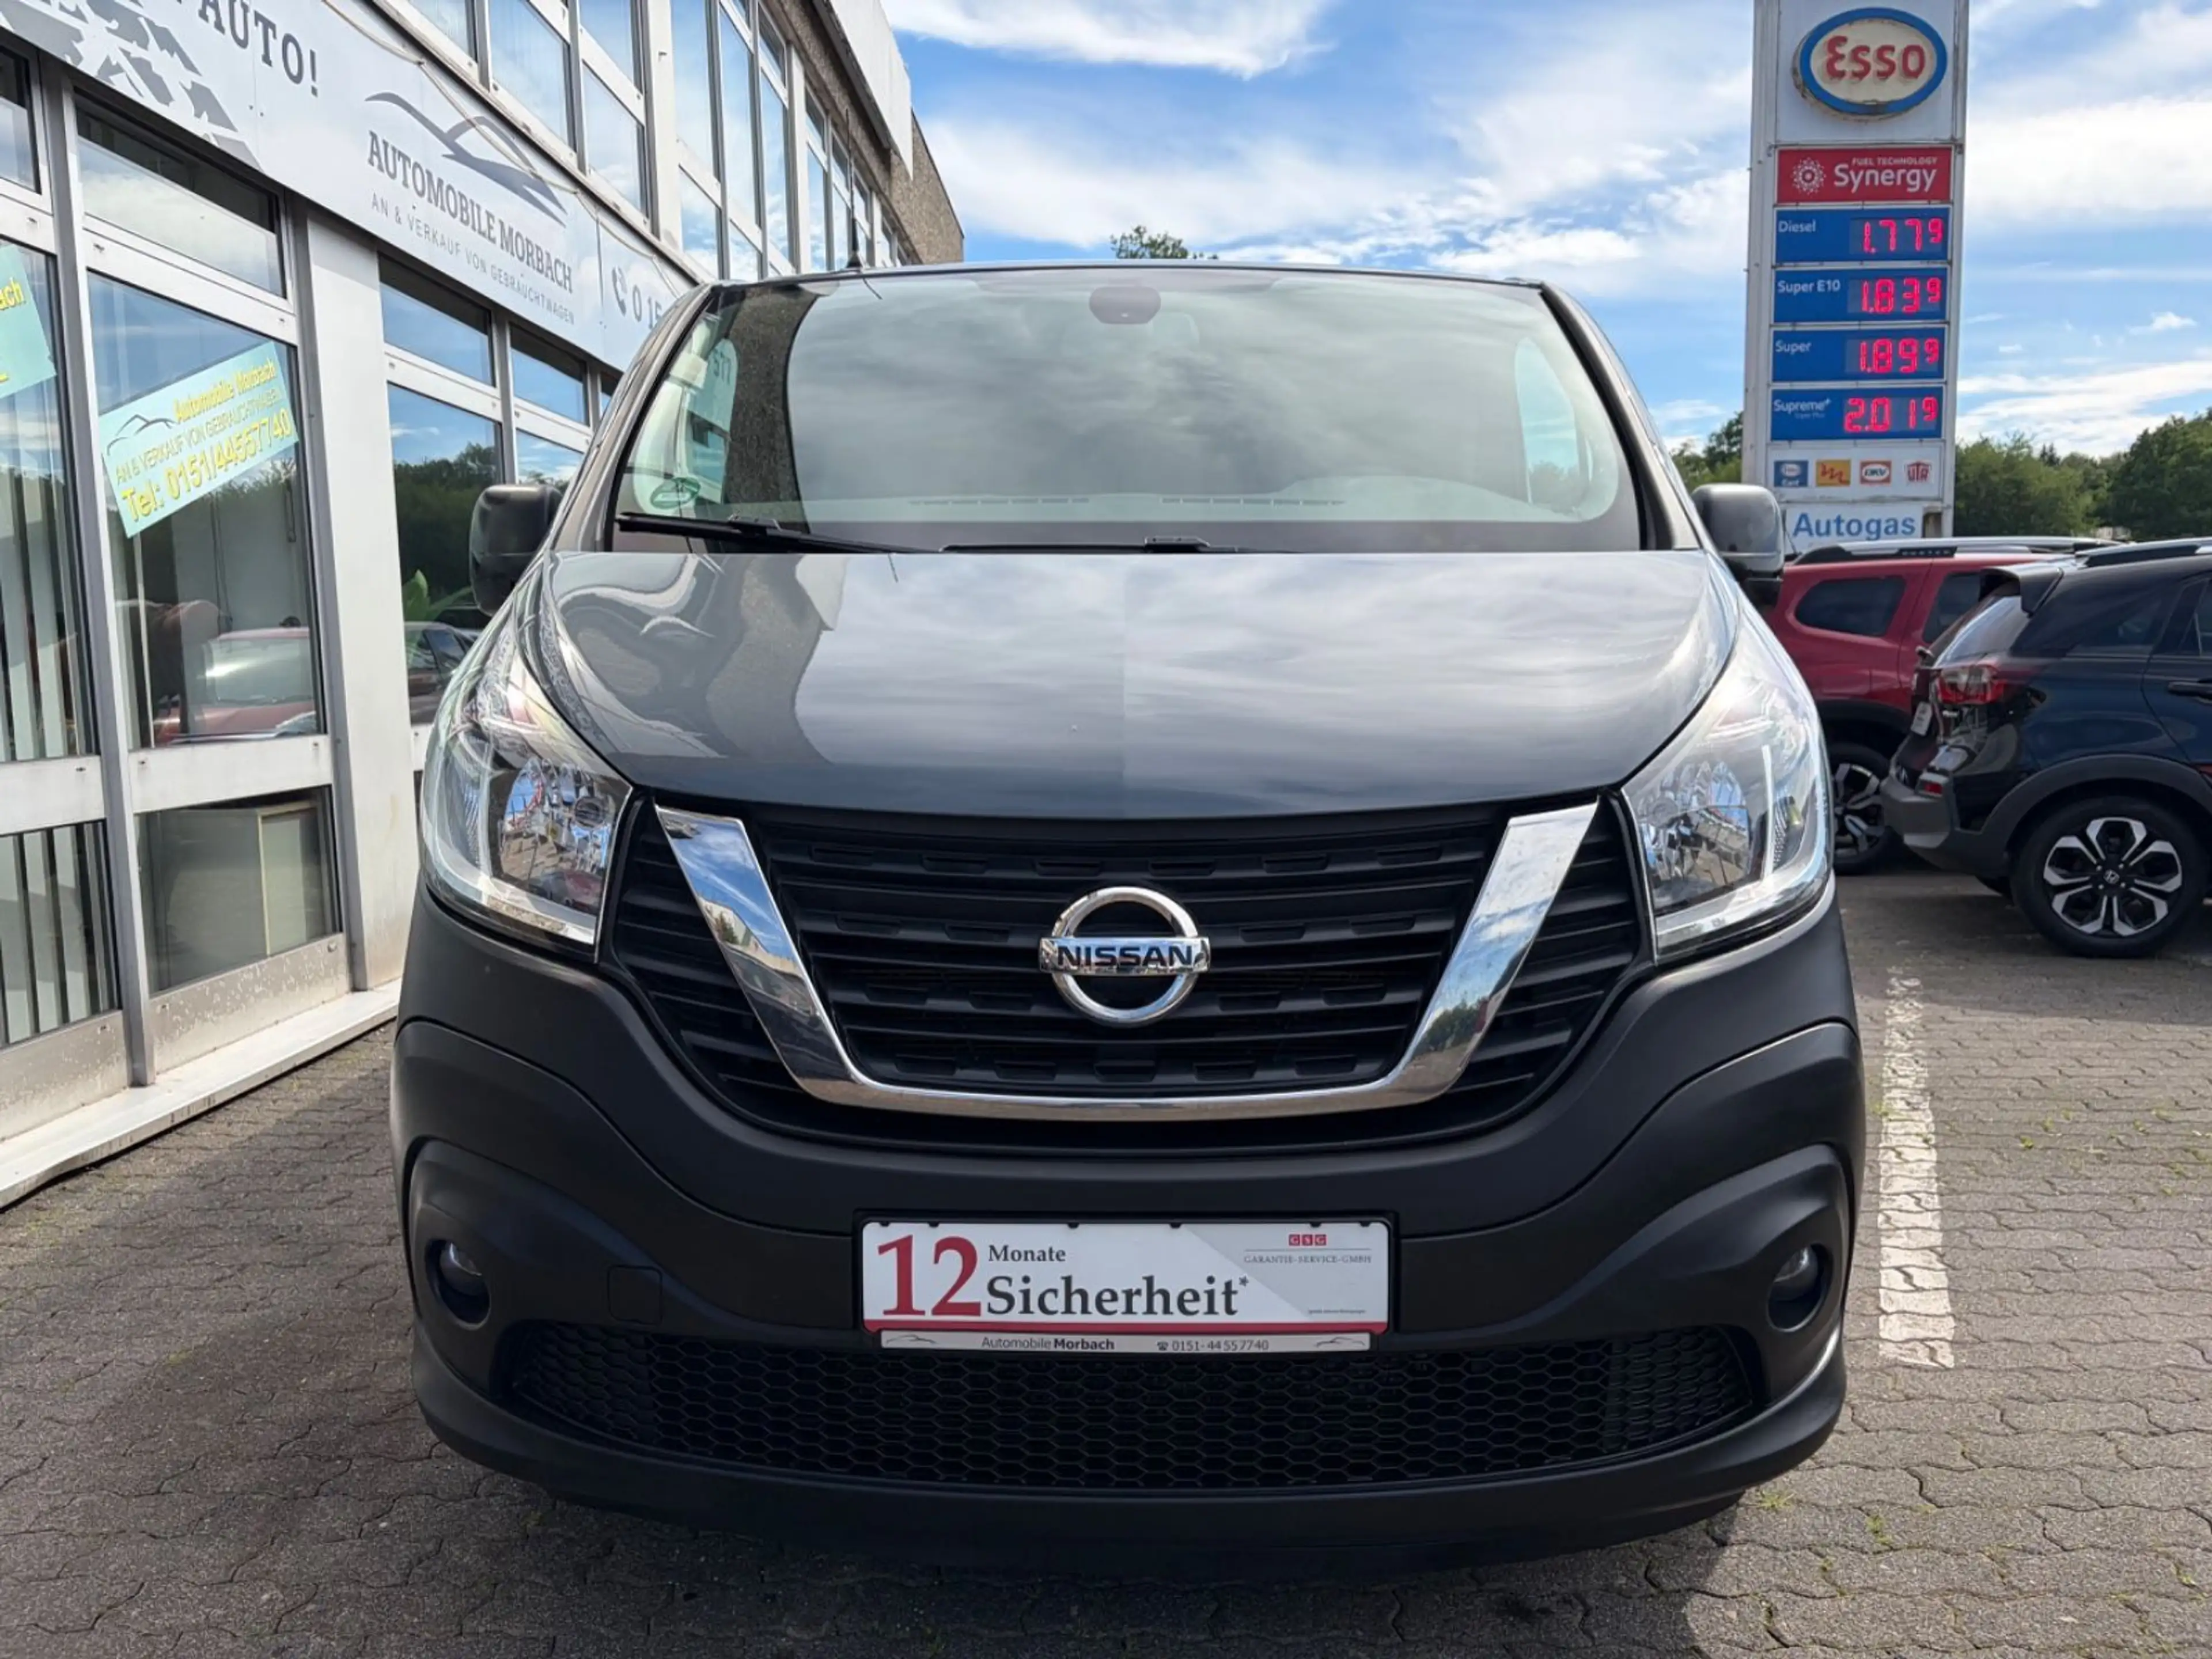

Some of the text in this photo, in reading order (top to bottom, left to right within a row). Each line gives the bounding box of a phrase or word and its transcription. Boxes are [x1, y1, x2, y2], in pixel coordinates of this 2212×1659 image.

[198, 0, 318, 97] AUTO!
[1852, 157, 1938, 166] FUEL TECHNOLOGY
[1834, 164, 1937, 193] Synergy
[368, 130, 573, 294] AUTOMOBILE MORBACH
[1778, 221, 1816, 233] Diesel
[372, 192, 575, 325] AN & VERKAUF VON GEBRAUCHTWAGEN
[1777, 281, 1814, 293] Super
[1817, 279, 1840, 292] E10
[1775, 340, 1812, 355] Super
[1793, 513, 1915, 541] Autogas
[1058, 946, 1192, 967] NISSAN
[988, 1245, 1066, 1262] Monate
[877, 1234, 982, 1316] 12
[982, 1336, 1115, 1350] Automobile Morbach
[1172, 1339, 1269, 1351] 0151-44557740
